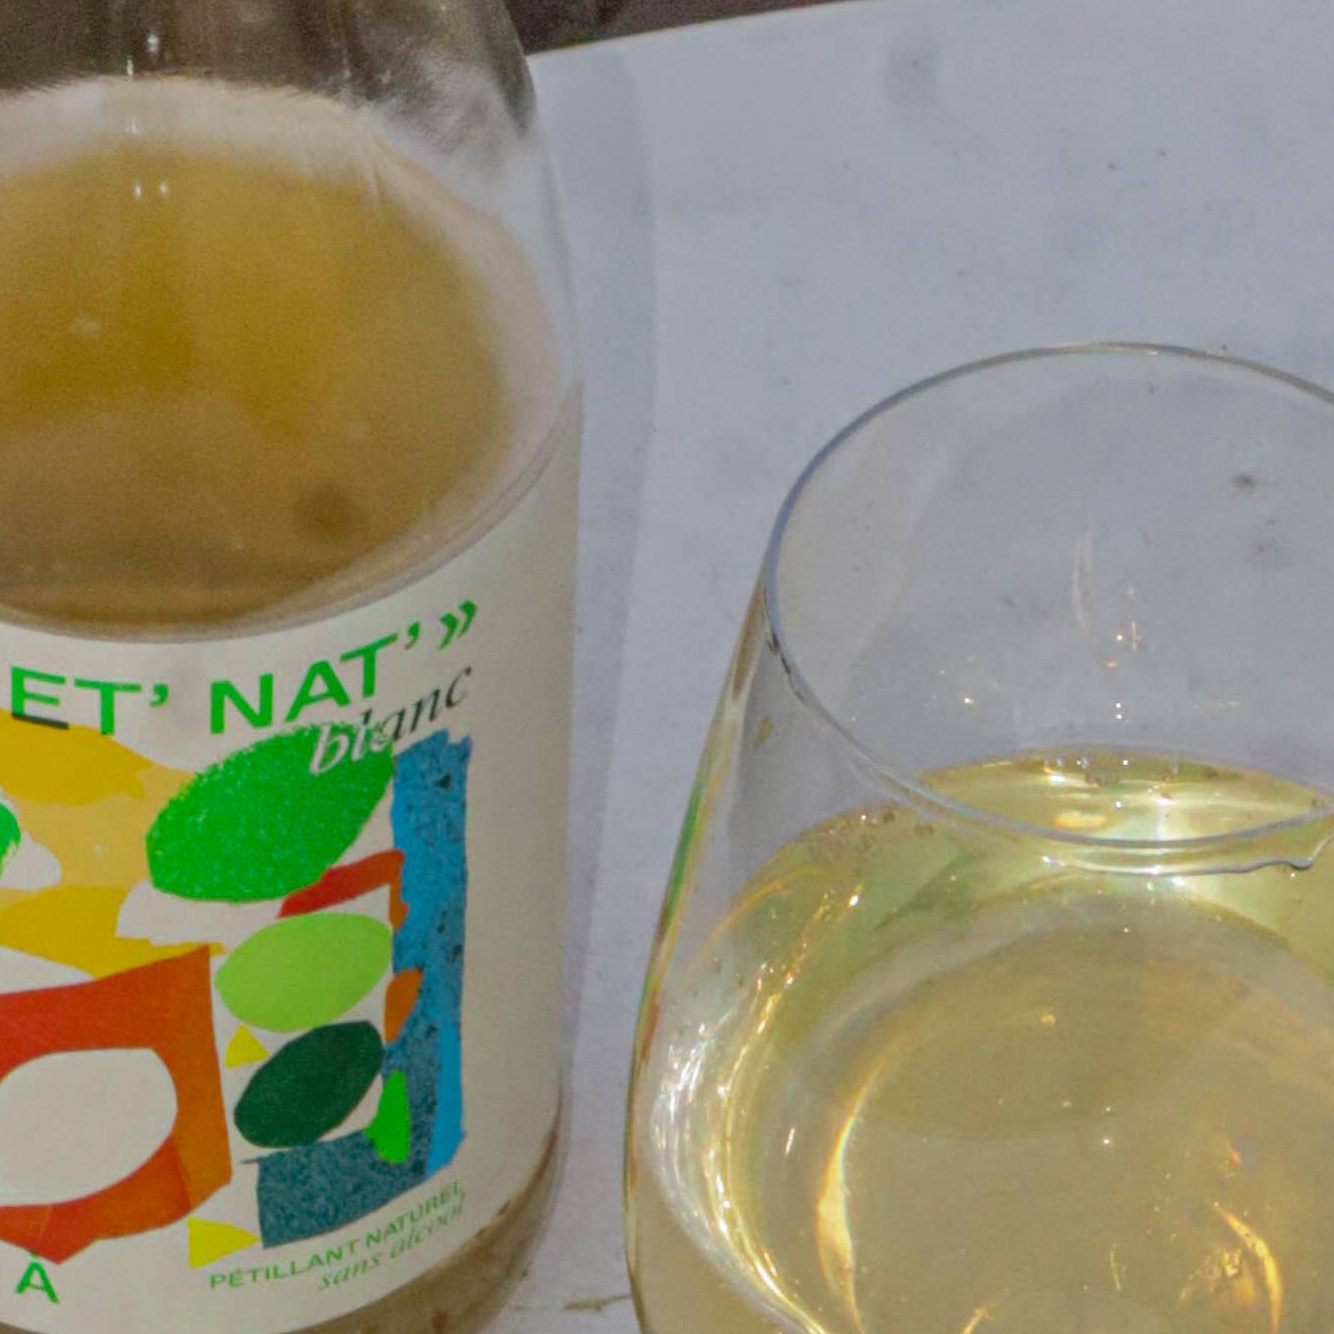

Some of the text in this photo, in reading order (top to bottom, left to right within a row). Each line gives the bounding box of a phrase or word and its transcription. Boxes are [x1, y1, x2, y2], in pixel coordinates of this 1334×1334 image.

[309, 666, 473, 775] blanc
[209, 1180, 464, 1290] PÉTILLANT NATUREL
[318, 1190, 467, 1291] sans alcool
